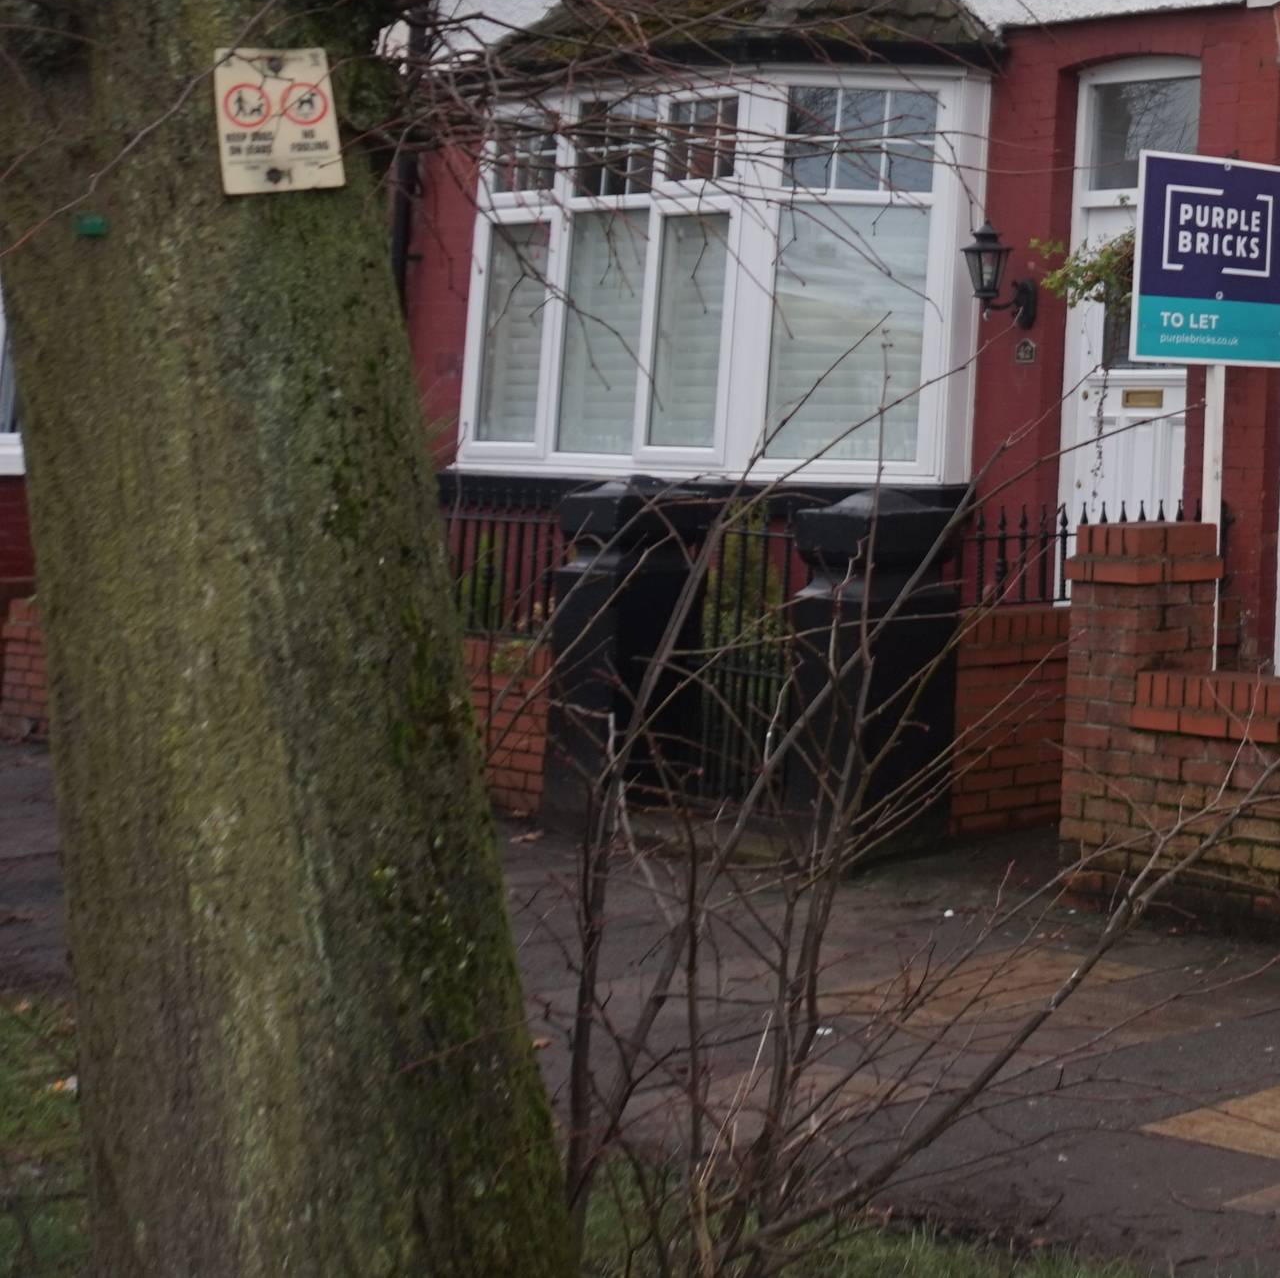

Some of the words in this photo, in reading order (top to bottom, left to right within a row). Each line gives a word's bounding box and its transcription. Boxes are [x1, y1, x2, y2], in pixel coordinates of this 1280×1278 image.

[1179, 203, 1261, 233] PURPLE
[1177, 230, 1260, 259] BRICKS
[1160, 311, 1184, 328] TO
[1189, 313, 1219, 330] LET
[1160, 333, 1239, 346] purplebricks.co.uk
